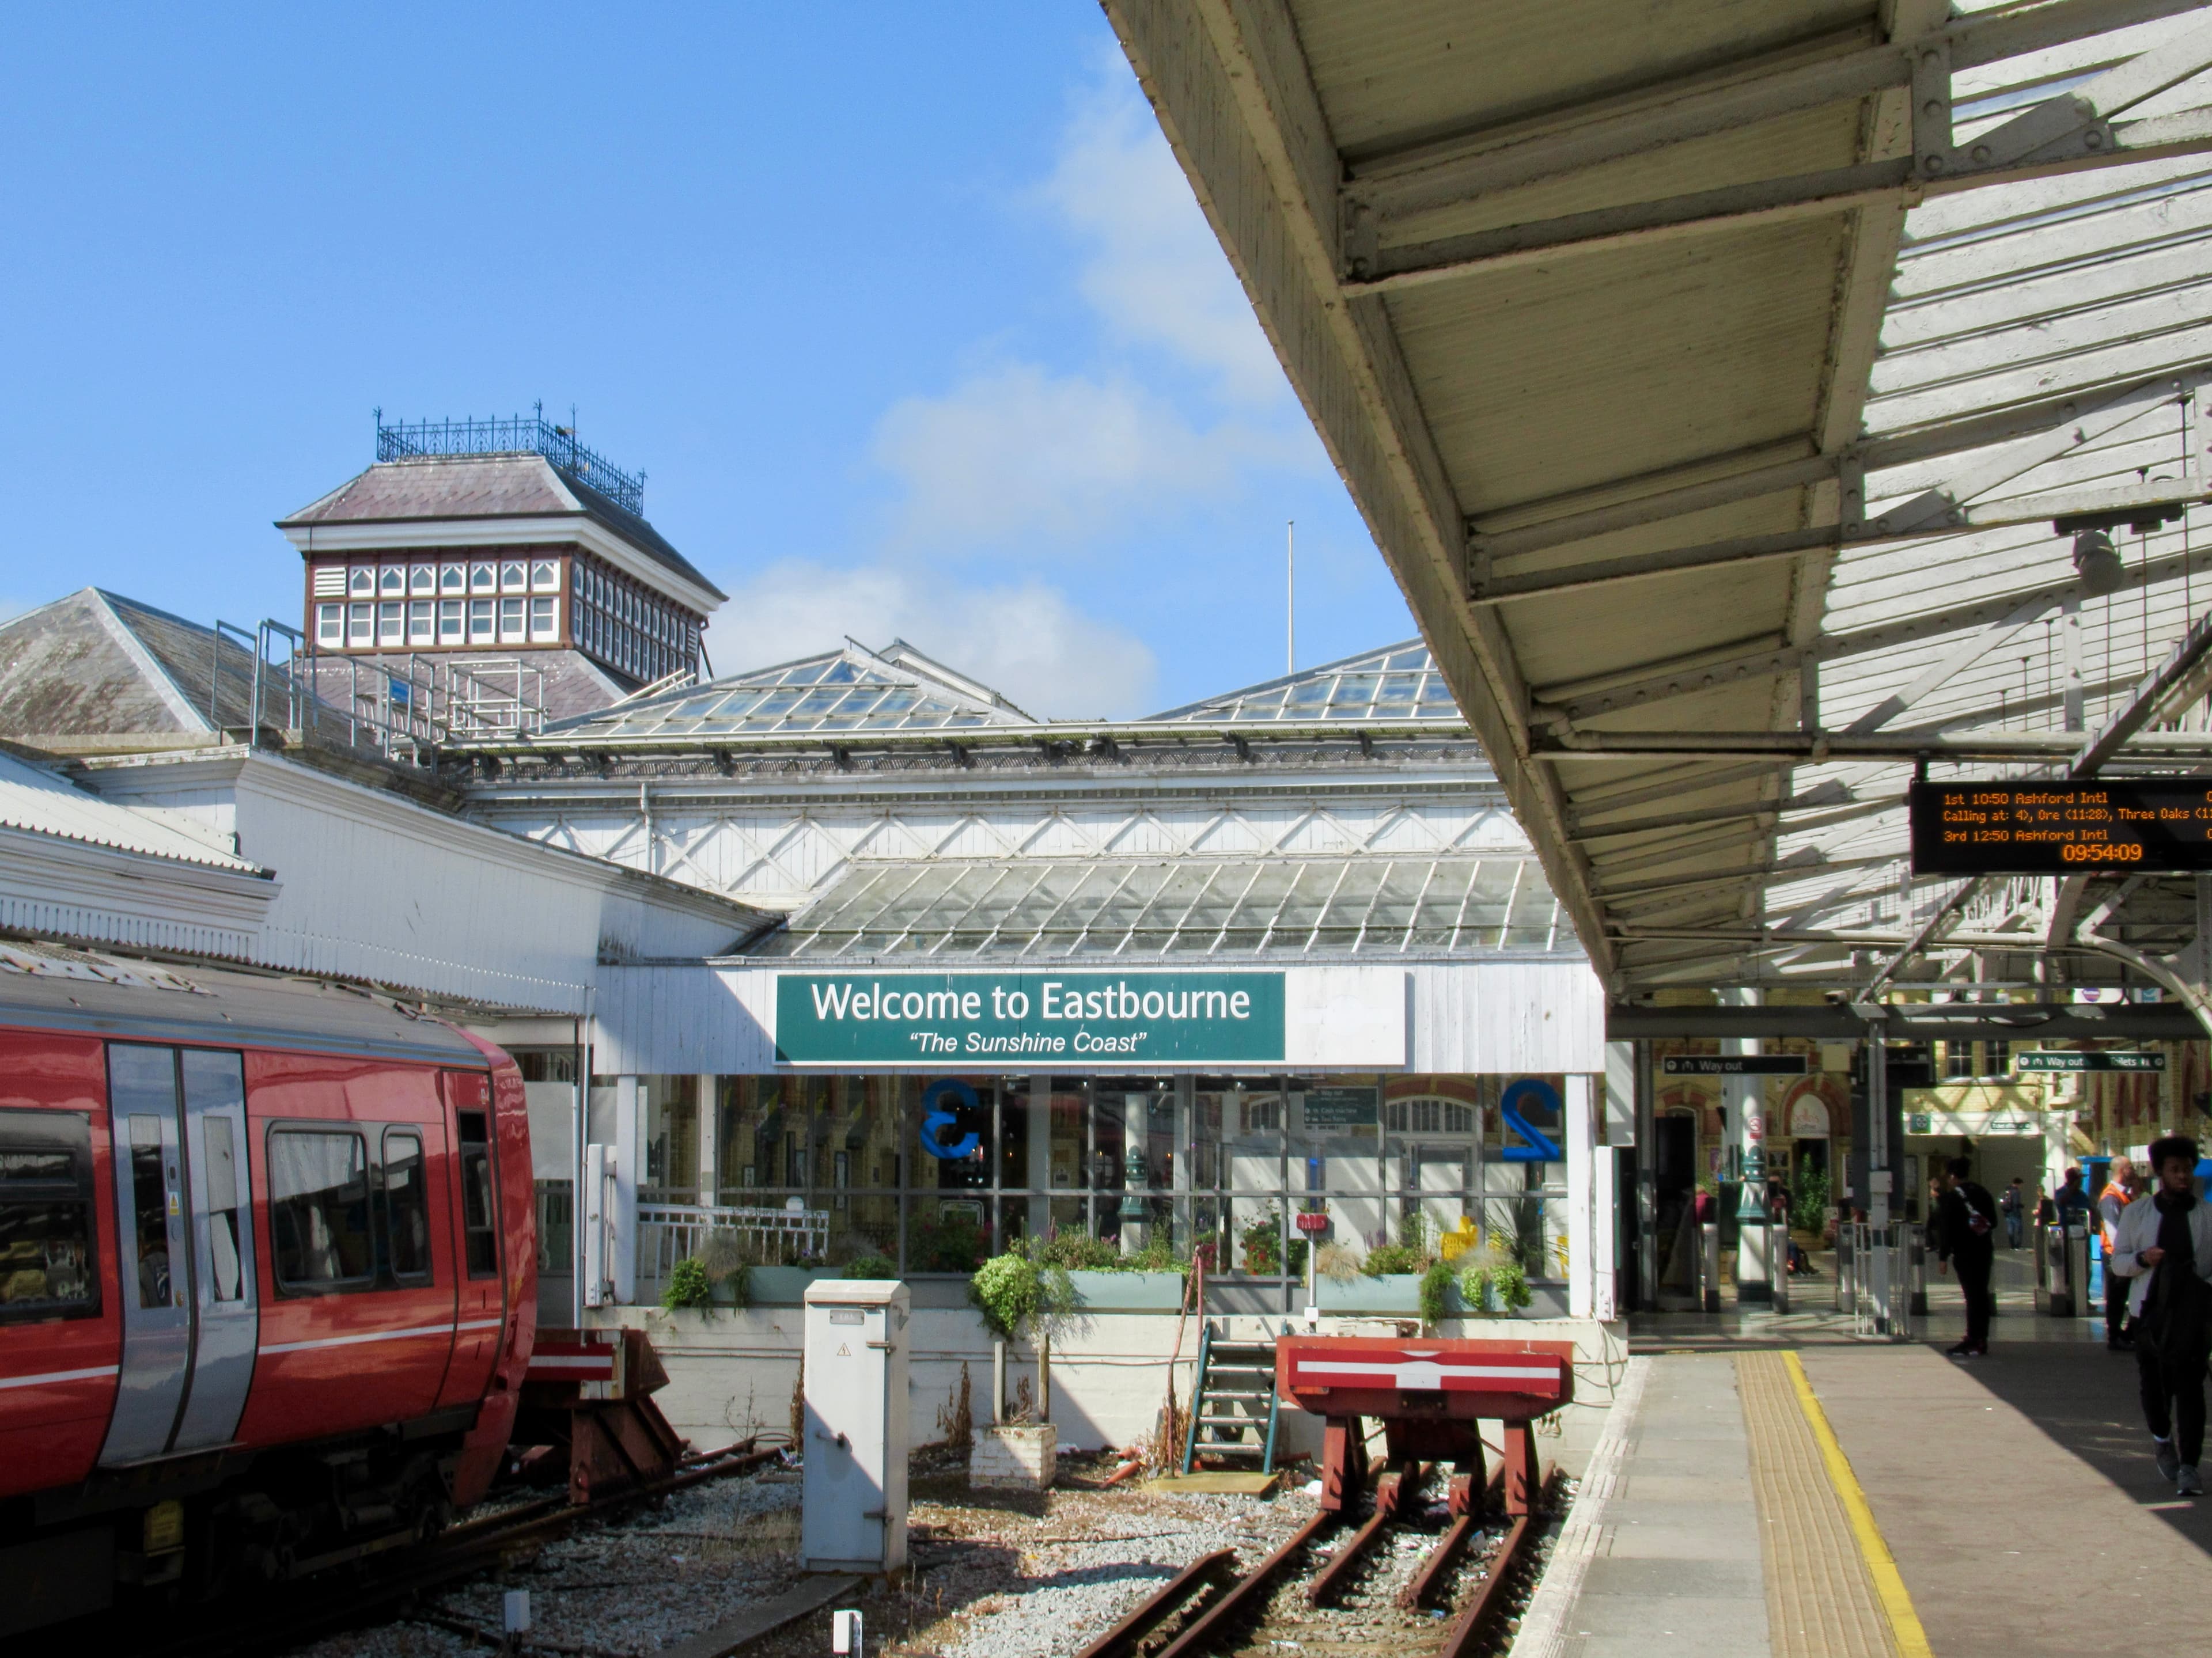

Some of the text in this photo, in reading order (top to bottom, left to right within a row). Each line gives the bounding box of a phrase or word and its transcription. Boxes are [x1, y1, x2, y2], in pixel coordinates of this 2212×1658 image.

[1944, 792, 2108, 805] 1st 10:50 Ashford Intl
[1944, 810, 1987, 824] Calling
[1991, 810, 2009, 821] at:
[2037, 810, 2060, 821] Ore
[2118, 808, 2155, 819] Three
[2160, 807, 2190, 819] Oaks
[1944, 829, 2108, 842] 3rd 12:50 Ashford Intl
[2062, 844, 2142, 862] 09:54:09
[810, 981, 1251, 1020] Welcome to Eastbourne
[909, 1033, 1148, 1052] “The Sunshine Coast”
[1699, 1060, 1744, 1073] Way out
[2046, 1057, 2084, 1068] Way out
[2109, 1056, 2137, 1066] Toilets
